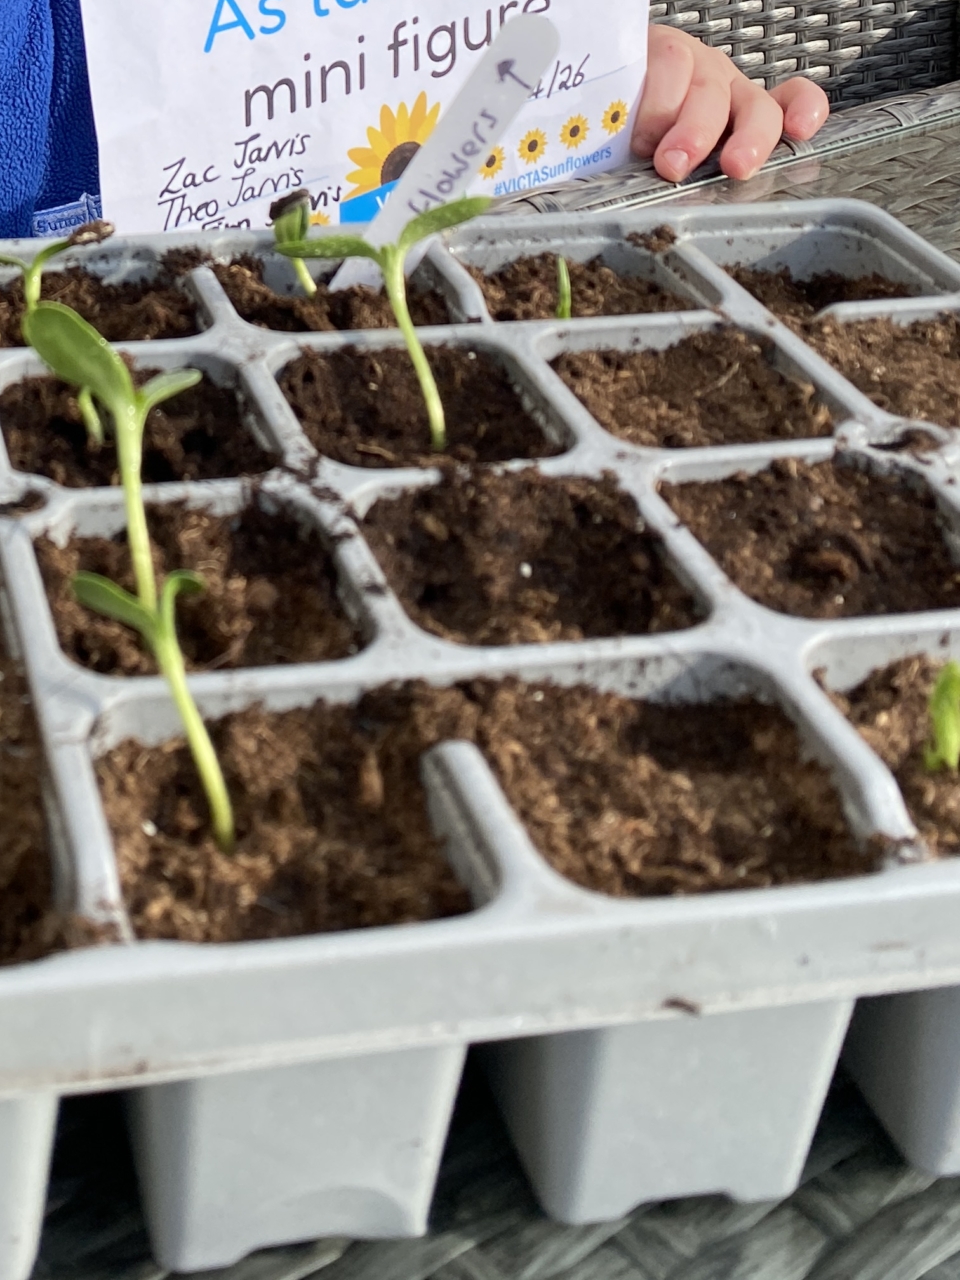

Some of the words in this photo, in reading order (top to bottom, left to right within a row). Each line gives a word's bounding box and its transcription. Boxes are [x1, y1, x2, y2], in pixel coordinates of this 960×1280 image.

[244, 33, 366, 127] mini
[159, 157, 221, 199] Zac
[233, 133, 311, 169] Jarvis
[493, 146, 612, 197] #VICTASunflowers
[157, 194, 220, 232] Theo
